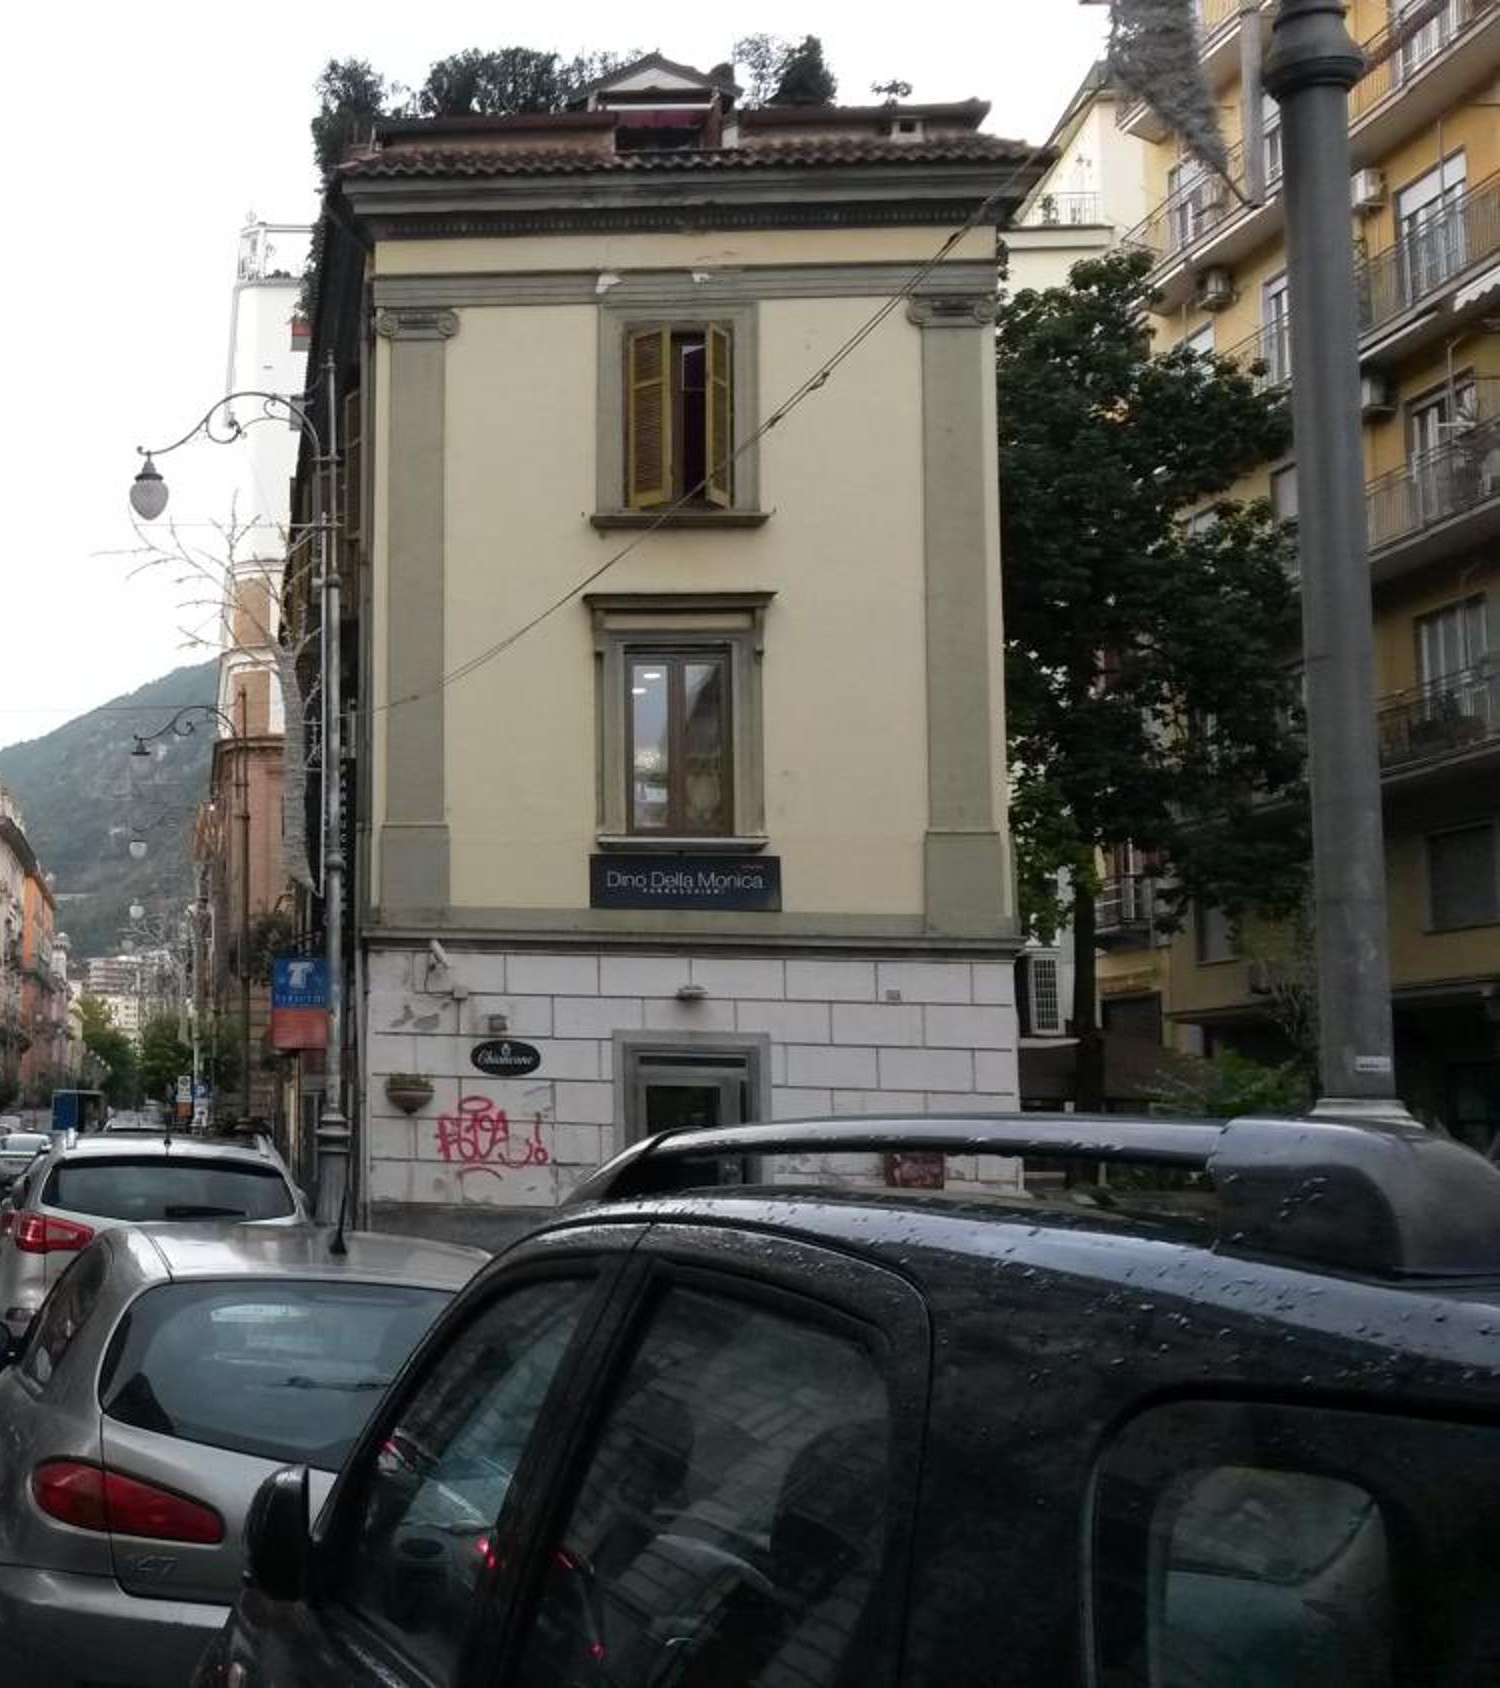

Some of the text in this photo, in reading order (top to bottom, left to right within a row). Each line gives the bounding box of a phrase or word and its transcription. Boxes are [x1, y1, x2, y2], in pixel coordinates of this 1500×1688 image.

[606, 871, 764, 889] Dino Della Monica
